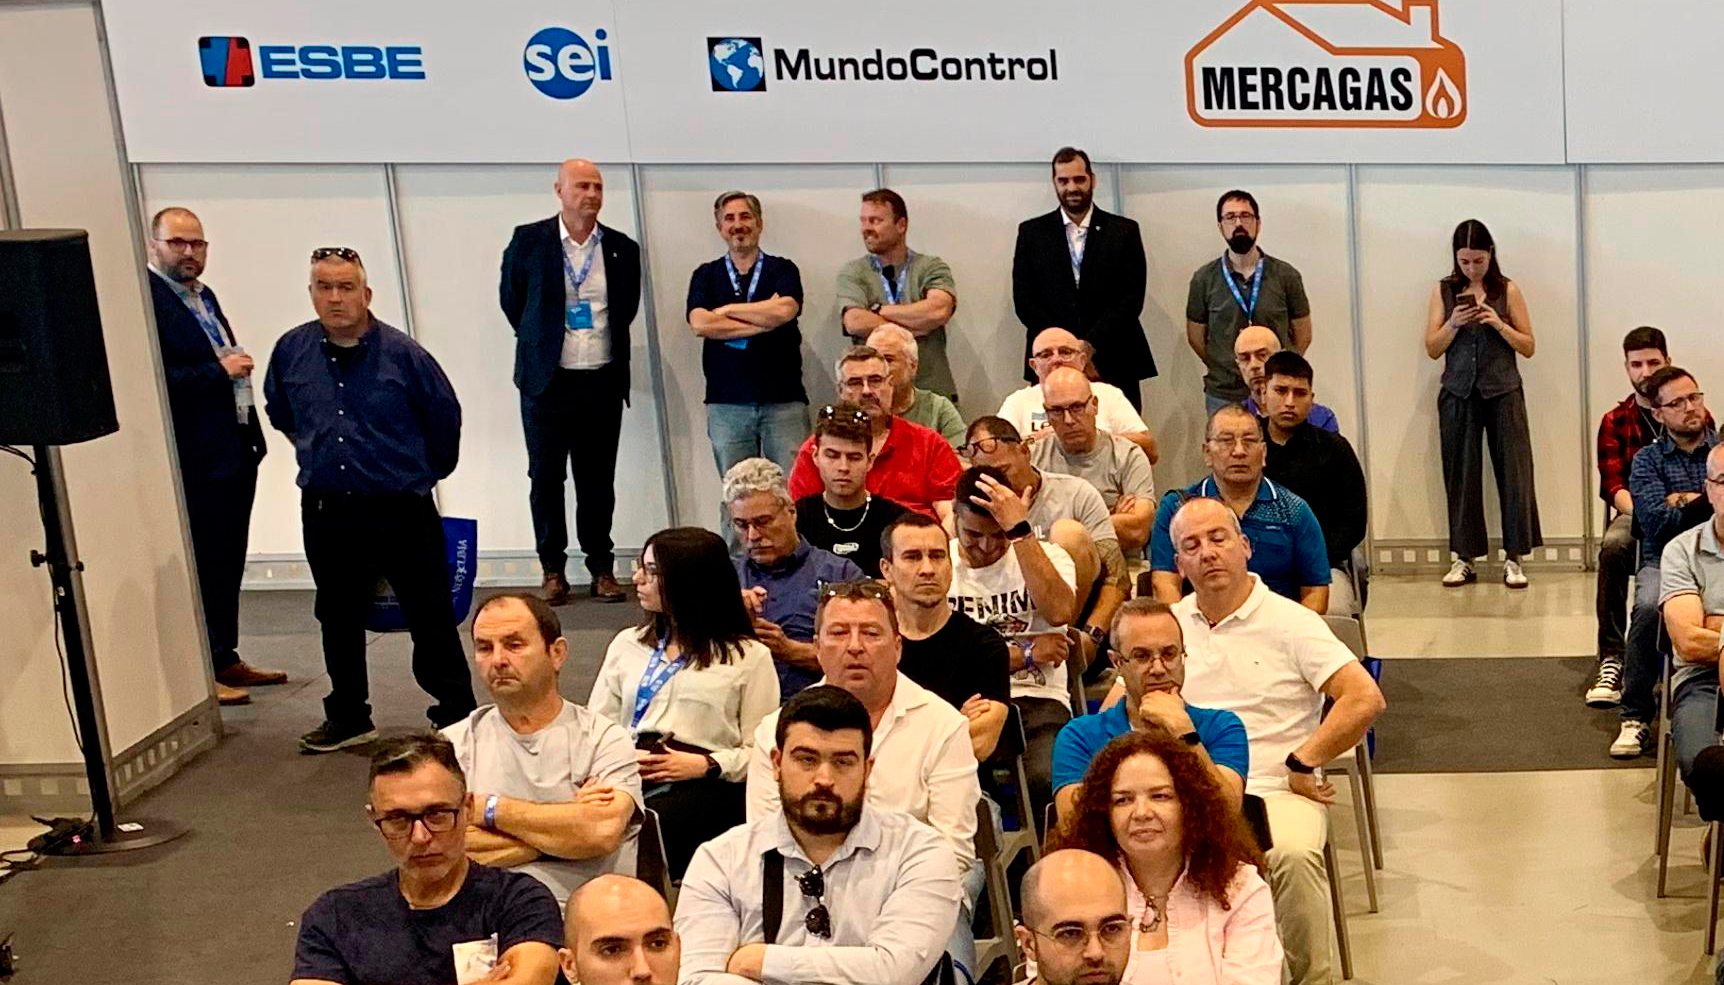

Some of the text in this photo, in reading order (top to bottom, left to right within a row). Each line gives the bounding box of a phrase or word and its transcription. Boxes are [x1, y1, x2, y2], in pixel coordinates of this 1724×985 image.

[258, 45, 426, 80] ESBE
[524, 28, 613, 82] sei
[773, 47, 1059, 81] MundoControl
[1201, 66, 1414, 111] MERCAGAS
